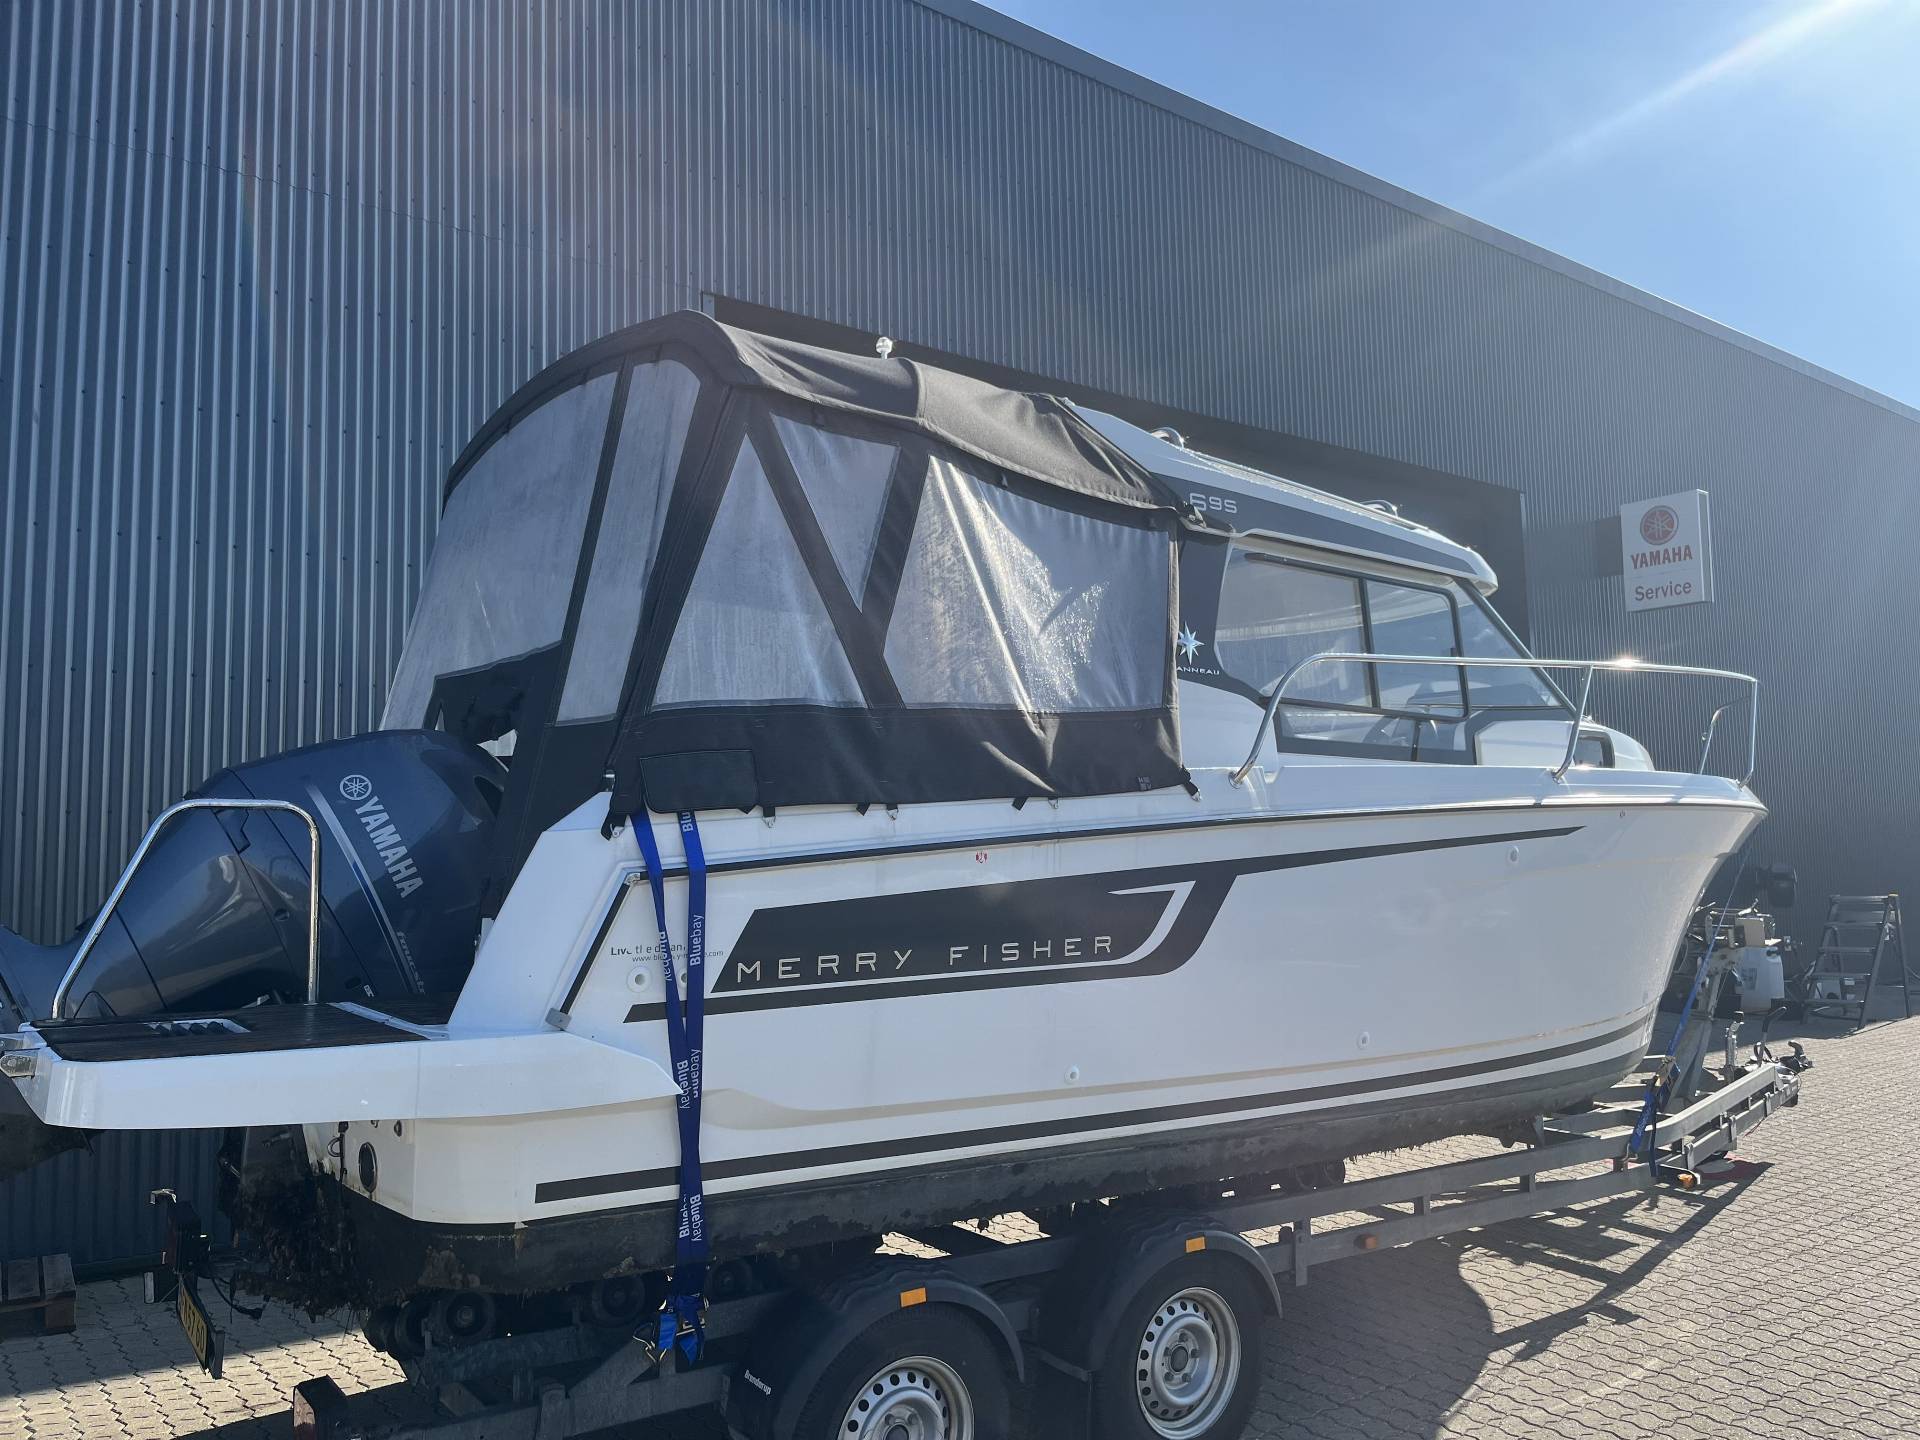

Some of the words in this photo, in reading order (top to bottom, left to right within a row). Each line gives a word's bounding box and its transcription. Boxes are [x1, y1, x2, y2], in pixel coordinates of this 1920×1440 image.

[1189, 492, 1238, 514] 695
[1630, 544, 1693, 570] YAMAHA
[1635, 580, 1692, 602] Service
[355, 795, 424, 899] YAMAHA
[690, 914, 704, 967] Bluebay
[736, 948, 912, 984] MERRY
[949, 935, 1112, 966] FISHER
[676, 1060, 691, 1109] Bluebay
[689, 1193, 704, 1242] Bluebay
